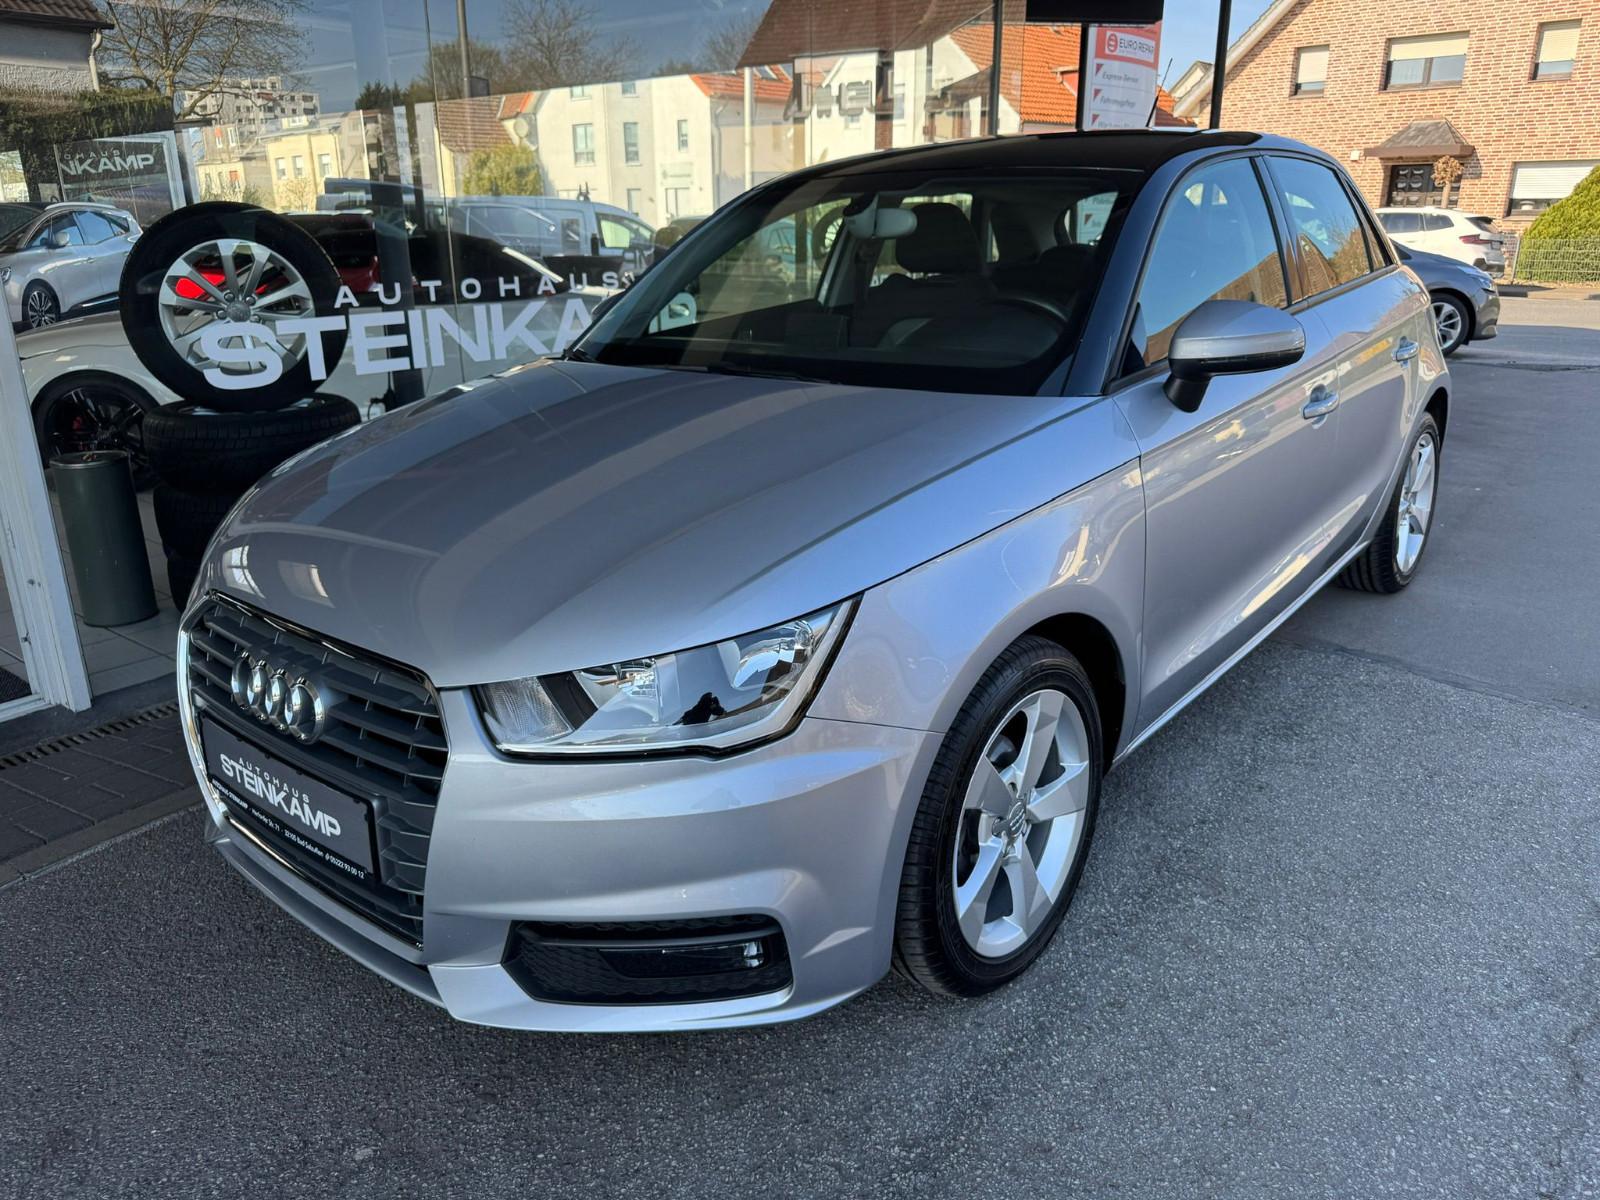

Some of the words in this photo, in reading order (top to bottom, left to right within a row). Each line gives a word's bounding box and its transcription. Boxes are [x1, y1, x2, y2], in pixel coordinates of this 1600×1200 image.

[1119, 38, 1137, 50] EURO
[334, 270, 620, 309] AUTOHAUS
[220, 753, 342, 838] STEINKAMP
[238, 757, 310, 803] AUTOHAUS
